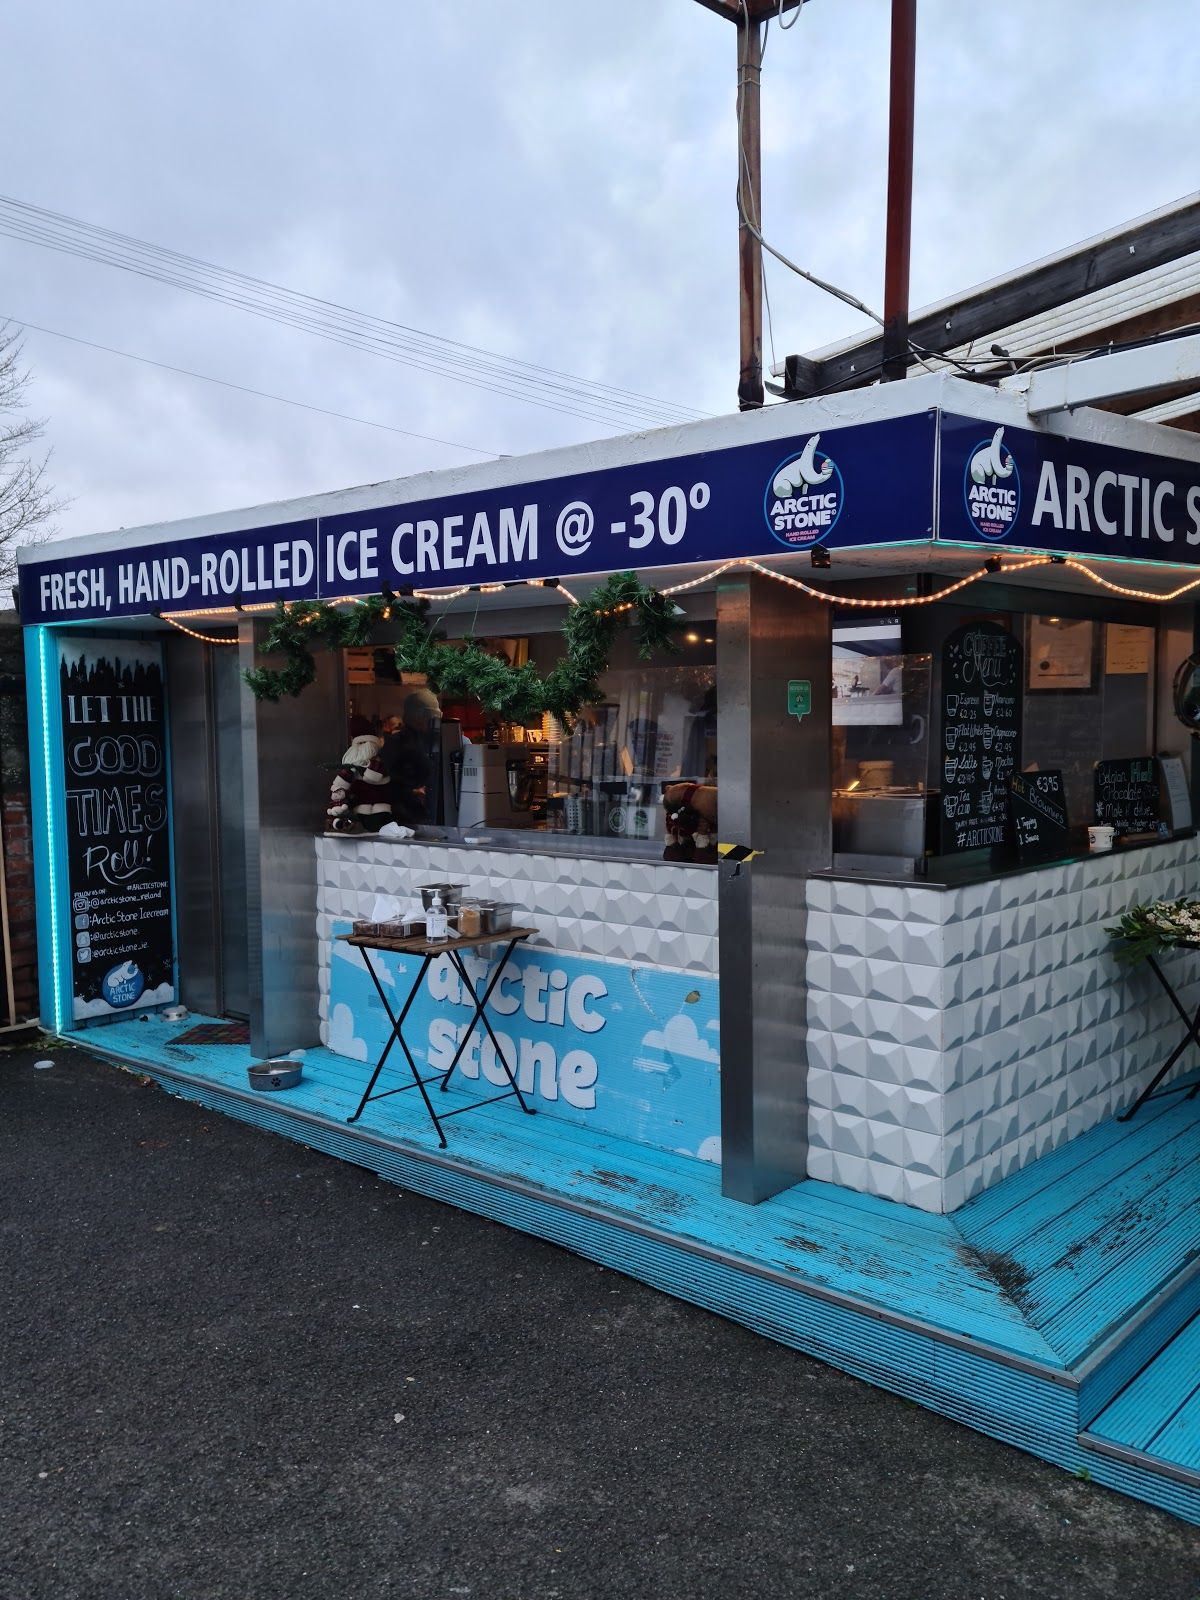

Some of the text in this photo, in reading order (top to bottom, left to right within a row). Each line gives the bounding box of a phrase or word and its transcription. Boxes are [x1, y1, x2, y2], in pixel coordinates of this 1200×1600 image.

[770, 492, 837, 516] ARCTIC
[968, 484, 1017, 506] ARCTIC
[971, 502, 1013, 522] STONE
[1031, 460, 1175, 543] ARCTIC
[774, 509, 832, 531] STONE
[39, 567, 112, 611] FRESH,
[118, 539, 314, 605] HAND-ROLLED
[326, 527, 379, 583] ICE
[391, 503, 539, 576] CREAM
[555, 500, 595, 557] @
[67, 695, 158, 724] LET THE
[67, 734, 162, 777] GOOD
[65, 783, 168, 836] TIMES
[1011, 777, 1025, 795] Hot
[1029, 787, 1065, 825] Brownies
[82, 834, 154, 886] Roll!
[109, 982, 136, 996] ARCTIC
[113, 992, 136, 1003] STONE
[427, 951, 609, 1033] arctic
[427, 1018, 598, 1110] stone
